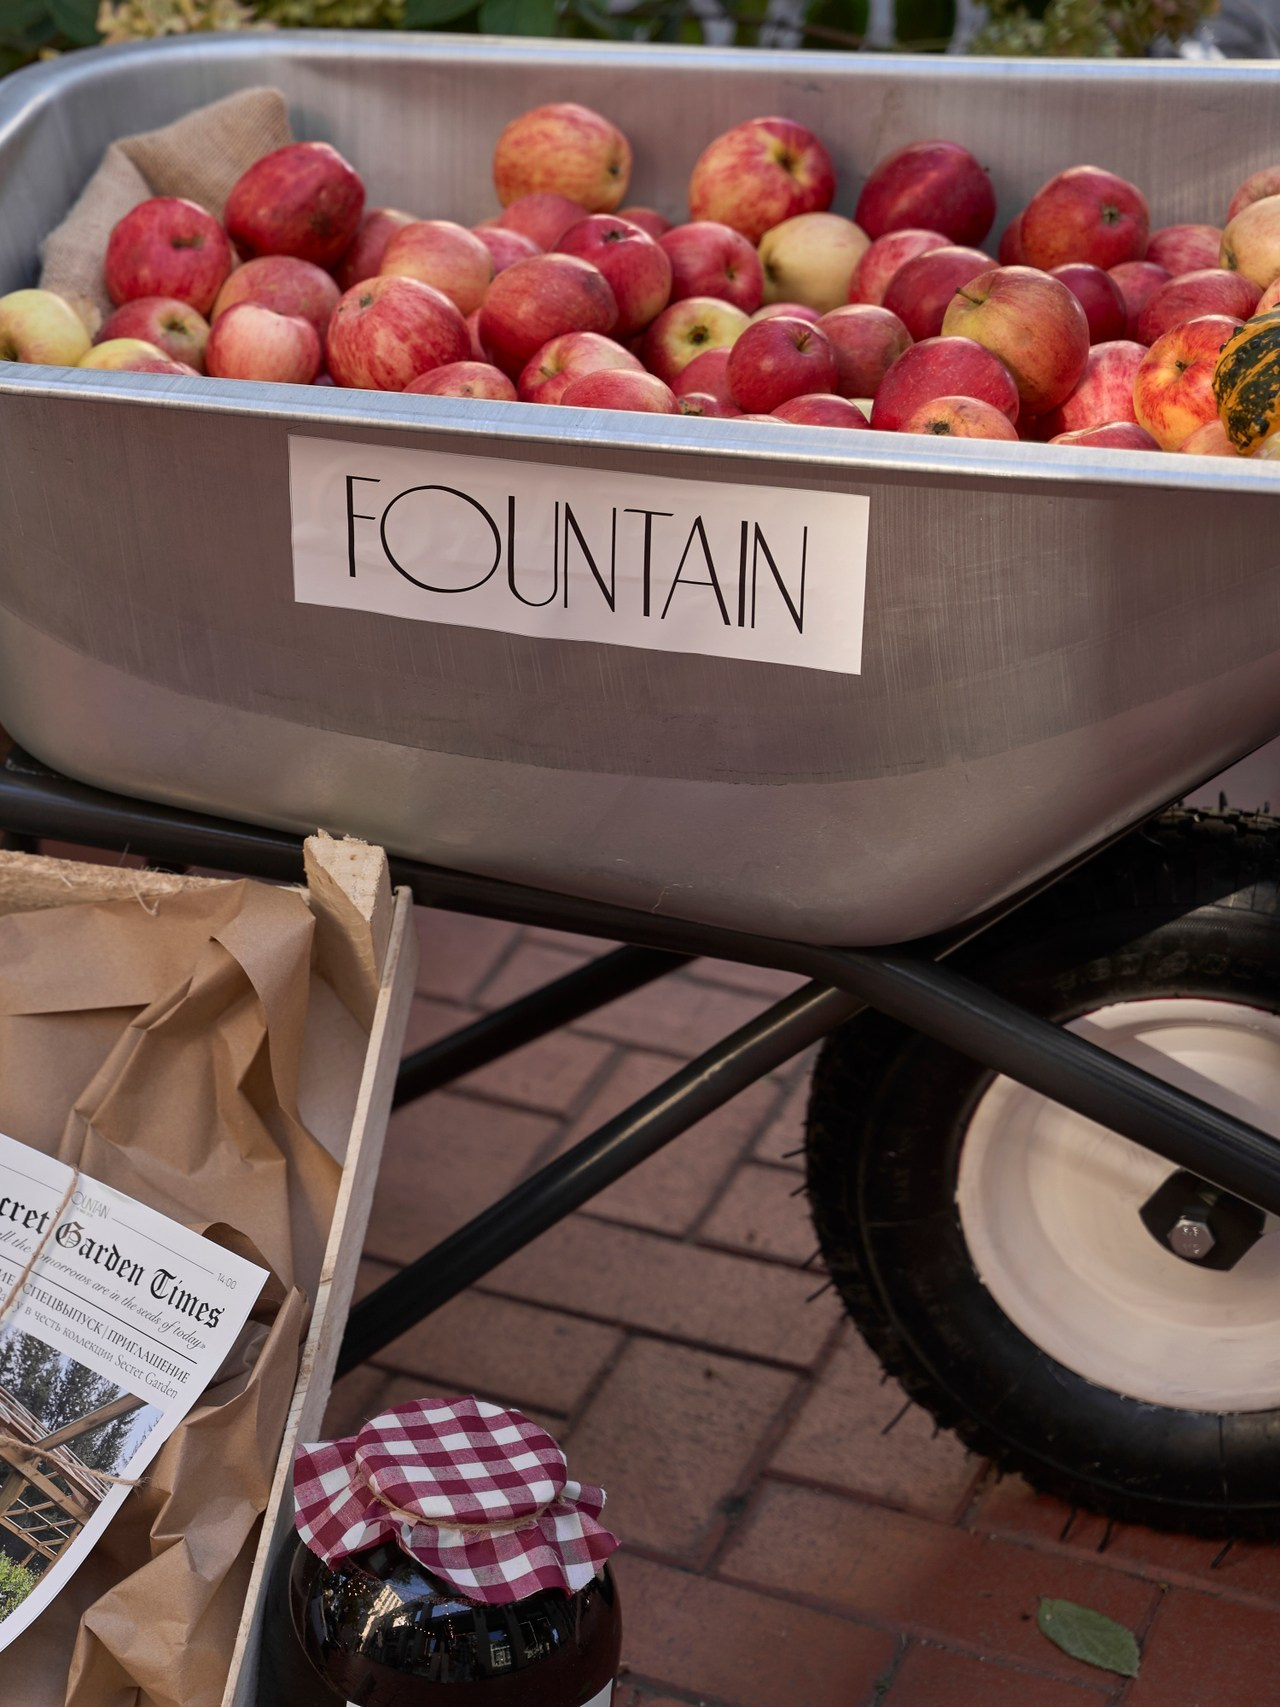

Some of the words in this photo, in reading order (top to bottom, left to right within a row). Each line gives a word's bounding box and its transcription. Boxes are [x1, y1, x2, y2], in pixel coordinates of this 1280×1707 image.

[345, 474, 808, 635] FOUNTAIN
[71, 1190, 110, 1219] OUNTAIN
[10, 1238, 32, 1253] the
[32, 1252, 91, 1286] omorrows
[91, 1280, 111, 1296] are
[108, 1288, 123, 1302] in
[119, 1293, 138, 1311] the
[135, 1303, 161, 1326] seeds
[155, 1317, 180, 1333] of
[55, 1220, 145, 1287] Garden
[149, 1268, 226, 1330] Times
[217, 1273, 237, 1290] 14:00
[22, 1283, 105, 1335] СПЕЦВЫПУСК
[107, 1329, 191, 1385] ПРИГЛАШЕНИЕ
[24, 1306, 32, 1316] в
[34, 1311, 61, 1333] честь
[62, 1327, 115, 1362] коллекции
[114, 1355, 144, 1380] Secret
[144, 1371, 179, 1400] Garden
